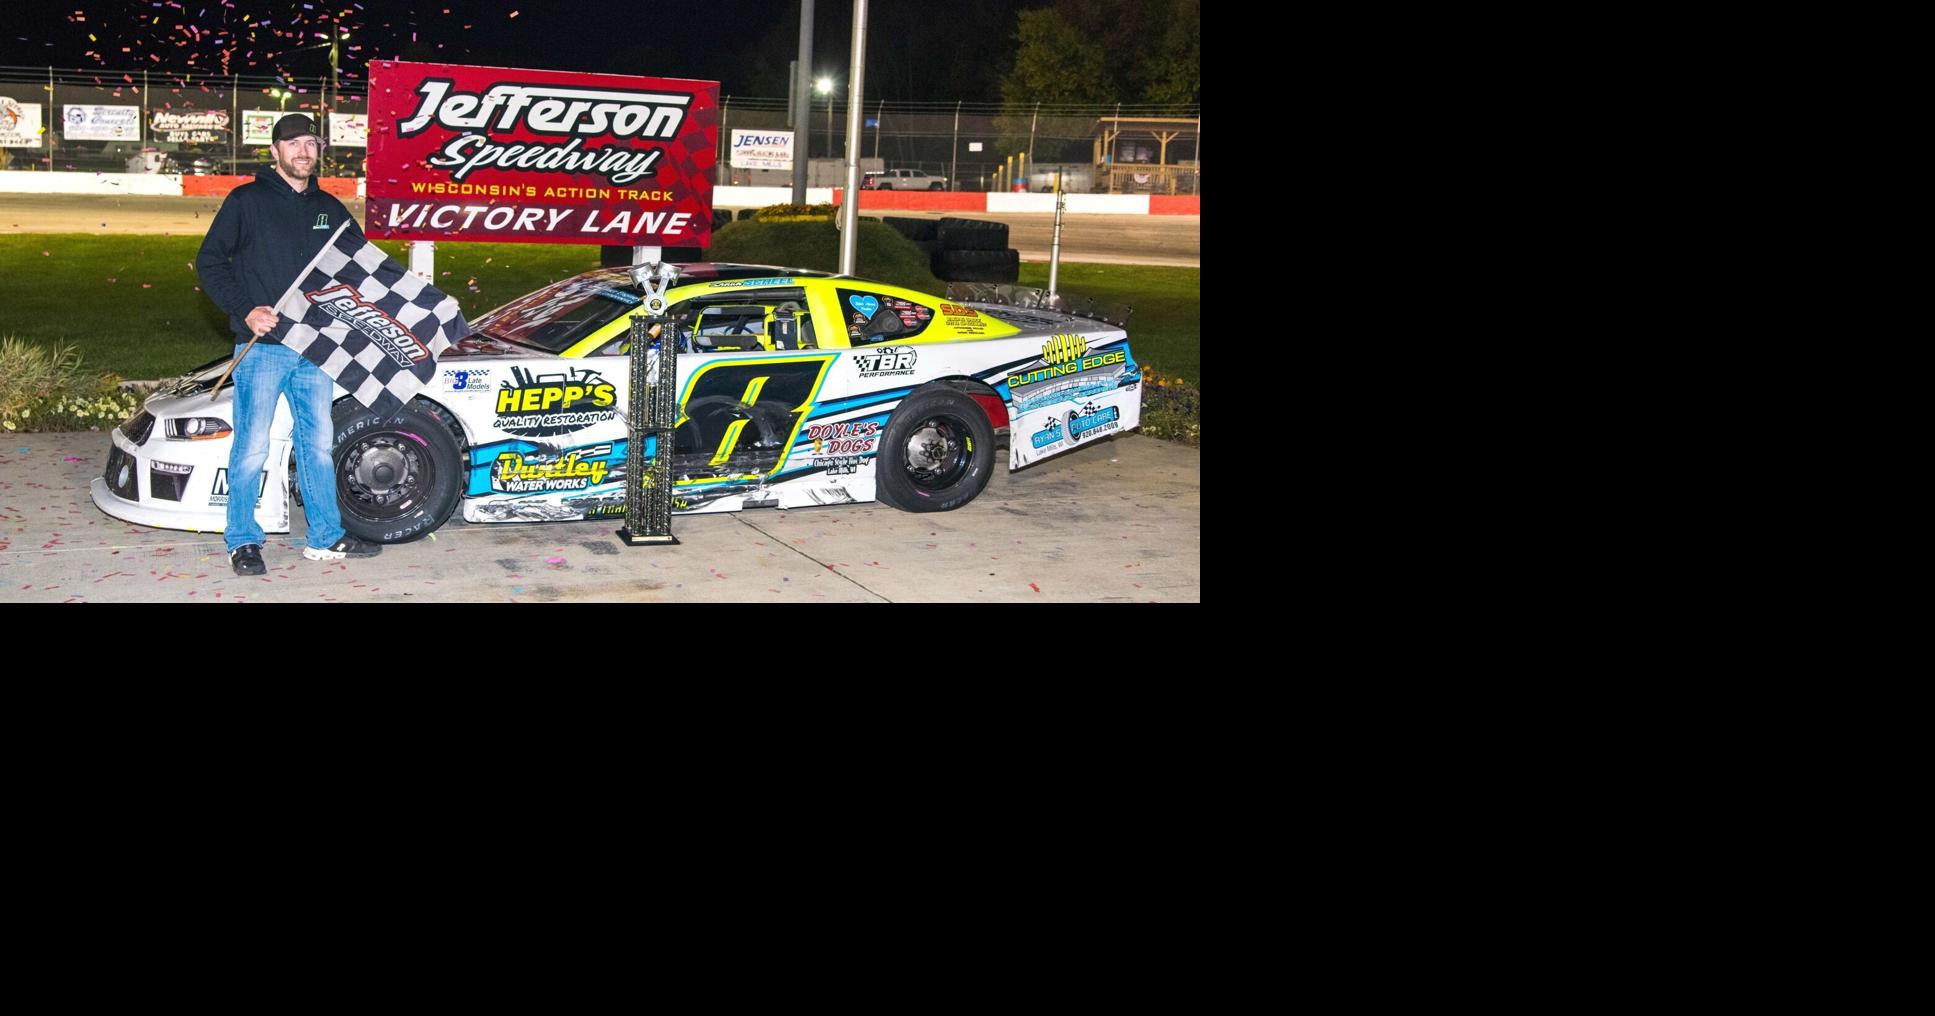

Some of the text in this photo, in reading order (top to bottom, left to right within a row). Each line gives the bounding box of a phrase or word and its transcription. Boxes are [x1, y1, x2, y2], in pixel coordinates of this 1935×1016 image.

[399, 80, 691, 138] Jefferson
[733, 135, 790, 148] JENSEN
[430, 135, 660, 183] Speedway
[412, 182, 674, 201] WISCONSIN'S ACTION TRACK
[387, 203, 692, 235] VICTORY LANE
[308, 286, 428, 360] Jefferson
[325, 304, 410, 365] SPEEDWAY
[866, 353, 912, 371] TBR
[1007, 351, 1125, 388] CUTTING EDGE
[452, 371, 469, 390] 3
[859, 369, 915, 378] PERFORMANCE
[496, 384, 615, 413] HEPP'S
[492, 411, 616, 428] QUALITY RESTORATION
[331, 416, 405, 449] MERICN
[807, 421, 880, 440] DOYLE'S
[828, 438, 876, 455] DOGS
[506, 478, 588, 491] WATER WORKS
